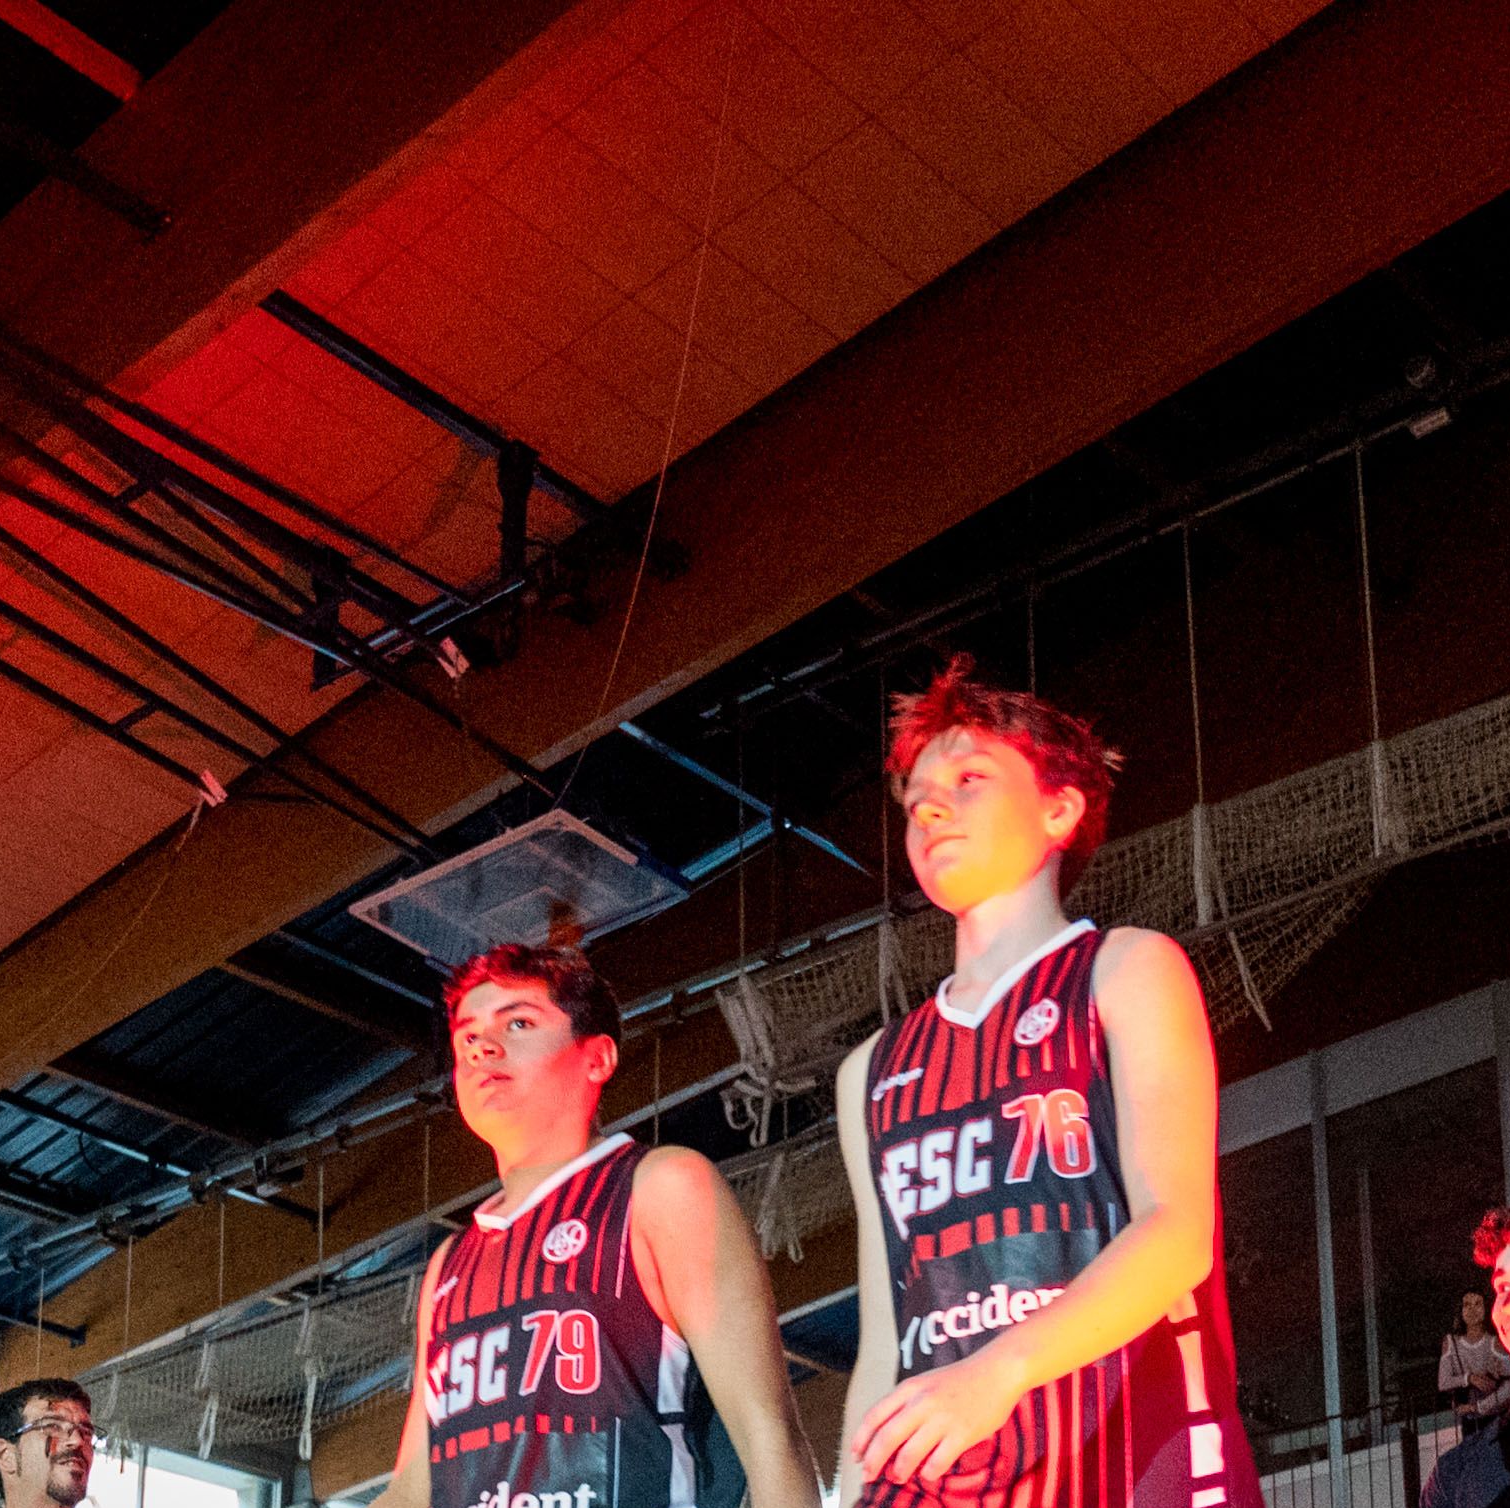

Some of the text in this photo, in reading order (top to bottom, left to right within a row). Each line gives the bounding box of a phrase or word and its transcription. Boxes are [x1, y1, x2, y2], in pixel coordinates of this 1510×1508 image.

[881, 1088, 1097, 1239] ESC 76
[519, 1309, 601, 1396] 79
